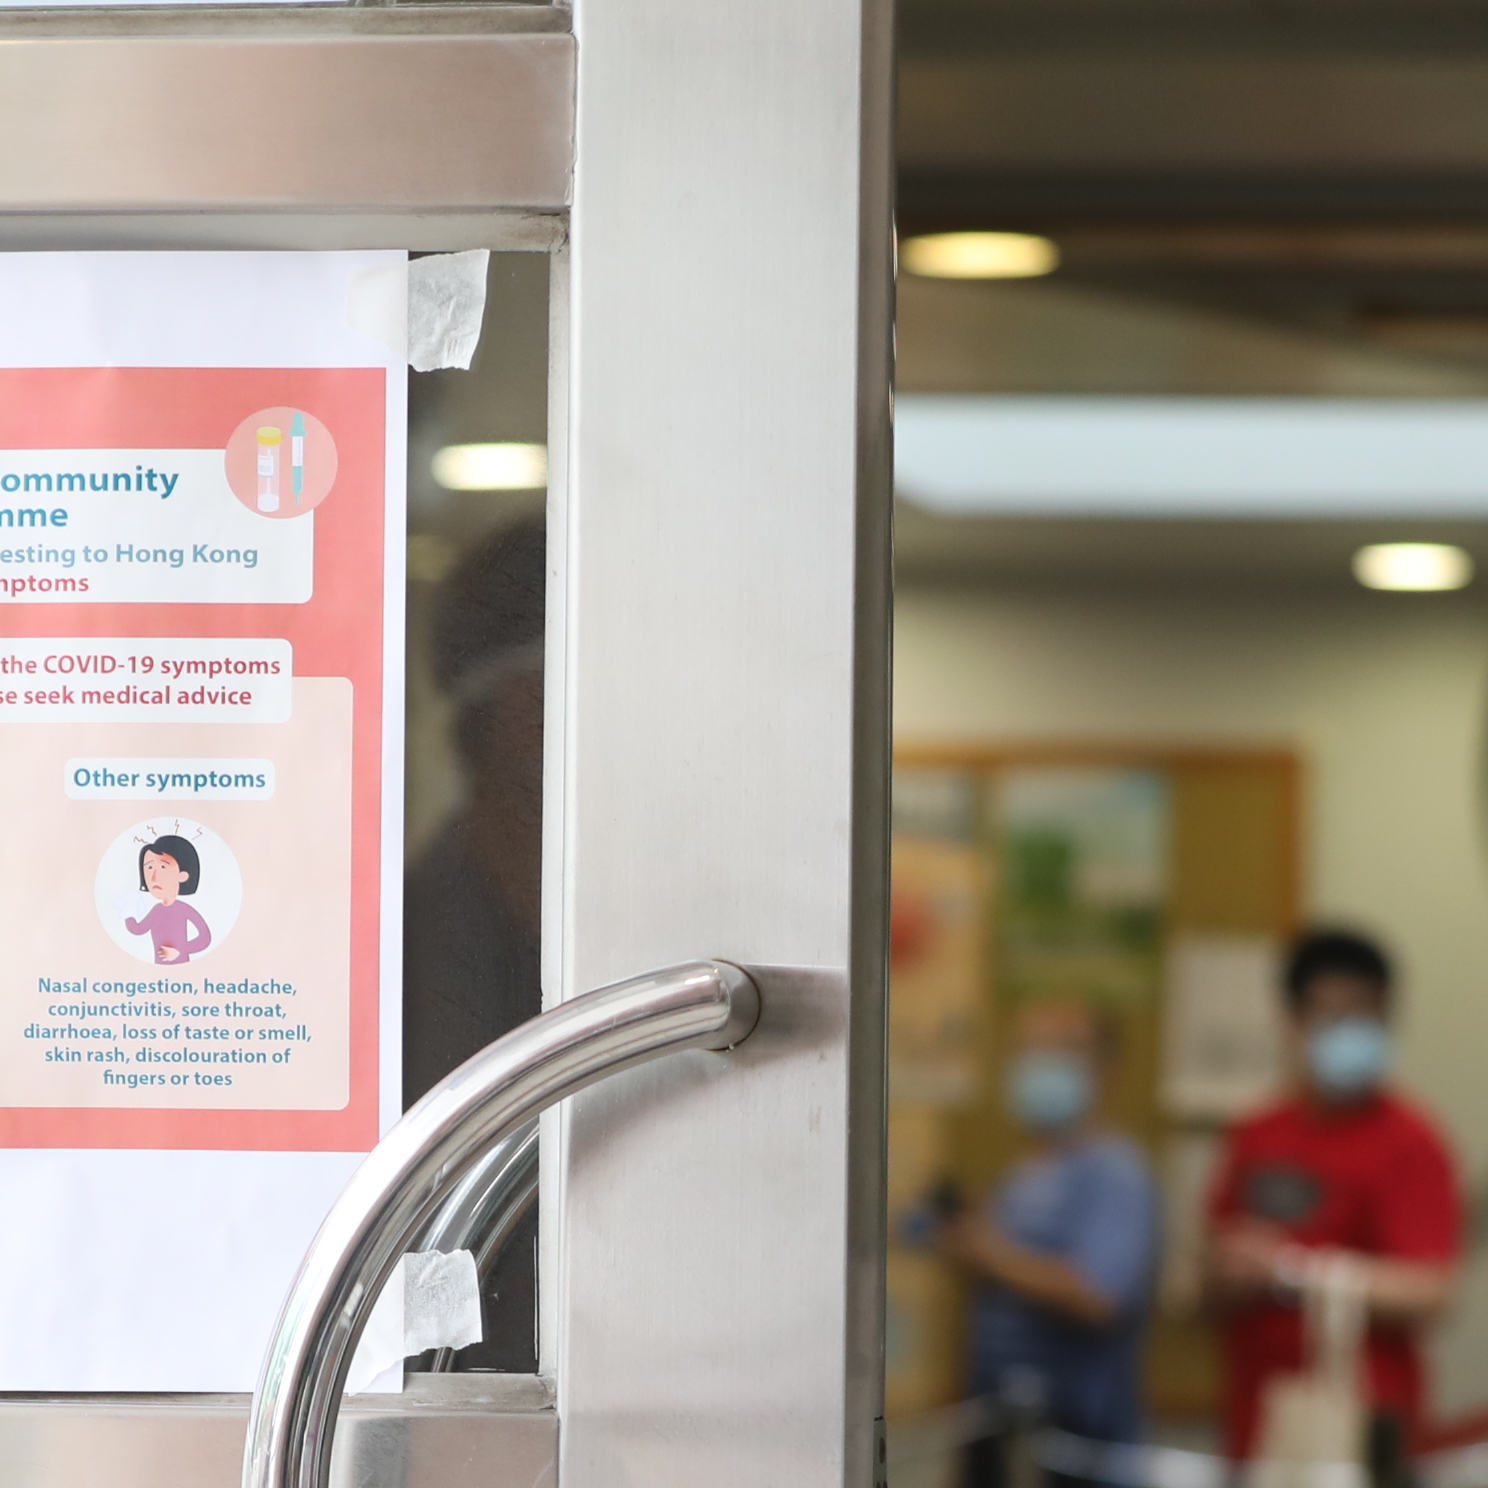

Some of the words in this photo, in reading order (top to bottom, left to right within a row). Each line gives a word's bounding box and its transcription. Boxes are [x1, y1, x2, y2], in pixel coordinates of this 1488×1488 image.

[83, 545, 108, 563] to
[116, 544, 184, 569] Hong
[193, 544, 258, 568] Kong
[1, 655, 37, 674] the
[44, 655, 154, 674] COVID-19
[161, 657, 280, 680] symptoms
[24, 685, 74, 705] seek
[82, 685, 170, 705] medical
[177, 685, 252, 706] advice
[74, 767, 140, 787] Other
[146, 771, 265, 793] symptoms
[39, 977, 87, 993] Nasal
[92, 978, 198, 998] congestion,
[204, 977, 296, 997] headache,
[48, 1001, 176, 1020] conjunctivitis,
[182, 1006, 219, 1018] sore
[225, 1001, 286, 1019] throat,
[24, 1022, 117, 1042] diarrhoea,
[123, 1024, 157, 1040] loss
[162, 1023, 180, 1040] of
[185, 1026, 229, 1040] taste
[235, 1028, 254, 1040] or
[259, 1024, 311, 1042] smell,
[45, 1046, 81, 1062] skin
[87, 1046, 130, 1064] rash,
[136, 1046, 266, 1063] discolouration
[272, 1047, 291, 1063] of
[103, 1069, 166, 1089] fingers
[170, 1074, 189, 1085] or
[194, 1071, 232, 1086] toes
